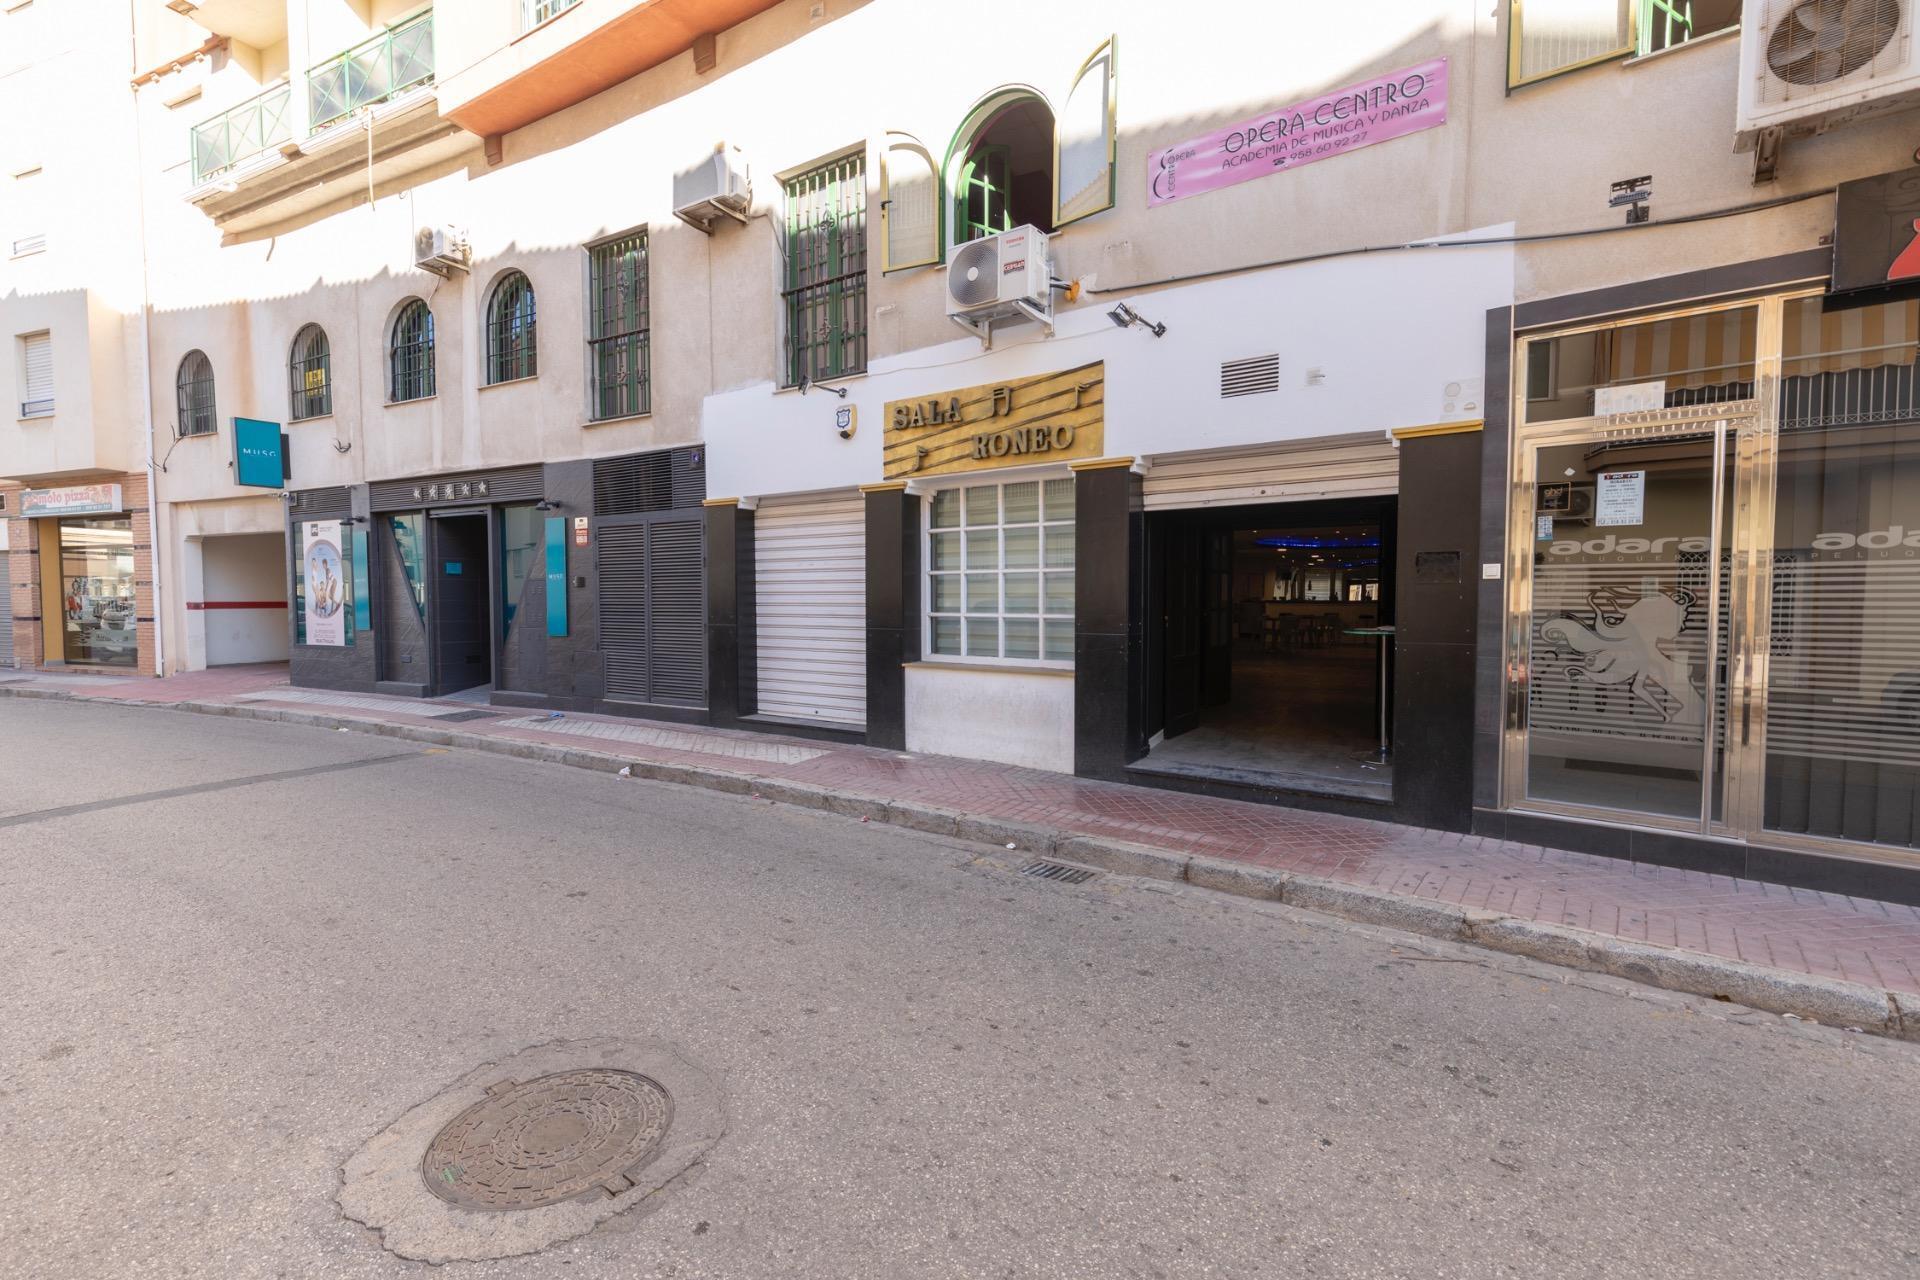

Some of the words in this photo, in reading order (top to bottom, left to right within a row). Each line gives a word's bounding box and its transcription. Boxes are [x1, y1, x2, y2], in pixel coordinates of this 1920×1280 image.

[1225, 113, 1304, 153] OPERA
[1315, 75, 1424, 125] CENTRO
[1222, 142, 1288, 169] ACADEMIA
[1291, 134, 1309, 149] DE
[1313, 118, 1364, 142] MUSICA
[1368, 113, 1377, 125] Y
[1382, 98, 1429, 121] DANZA
[893, 397, 963, 430] SALA
[972, 425, 1074, 459] RONEO
[1549, 534, 1712, 555] adara
